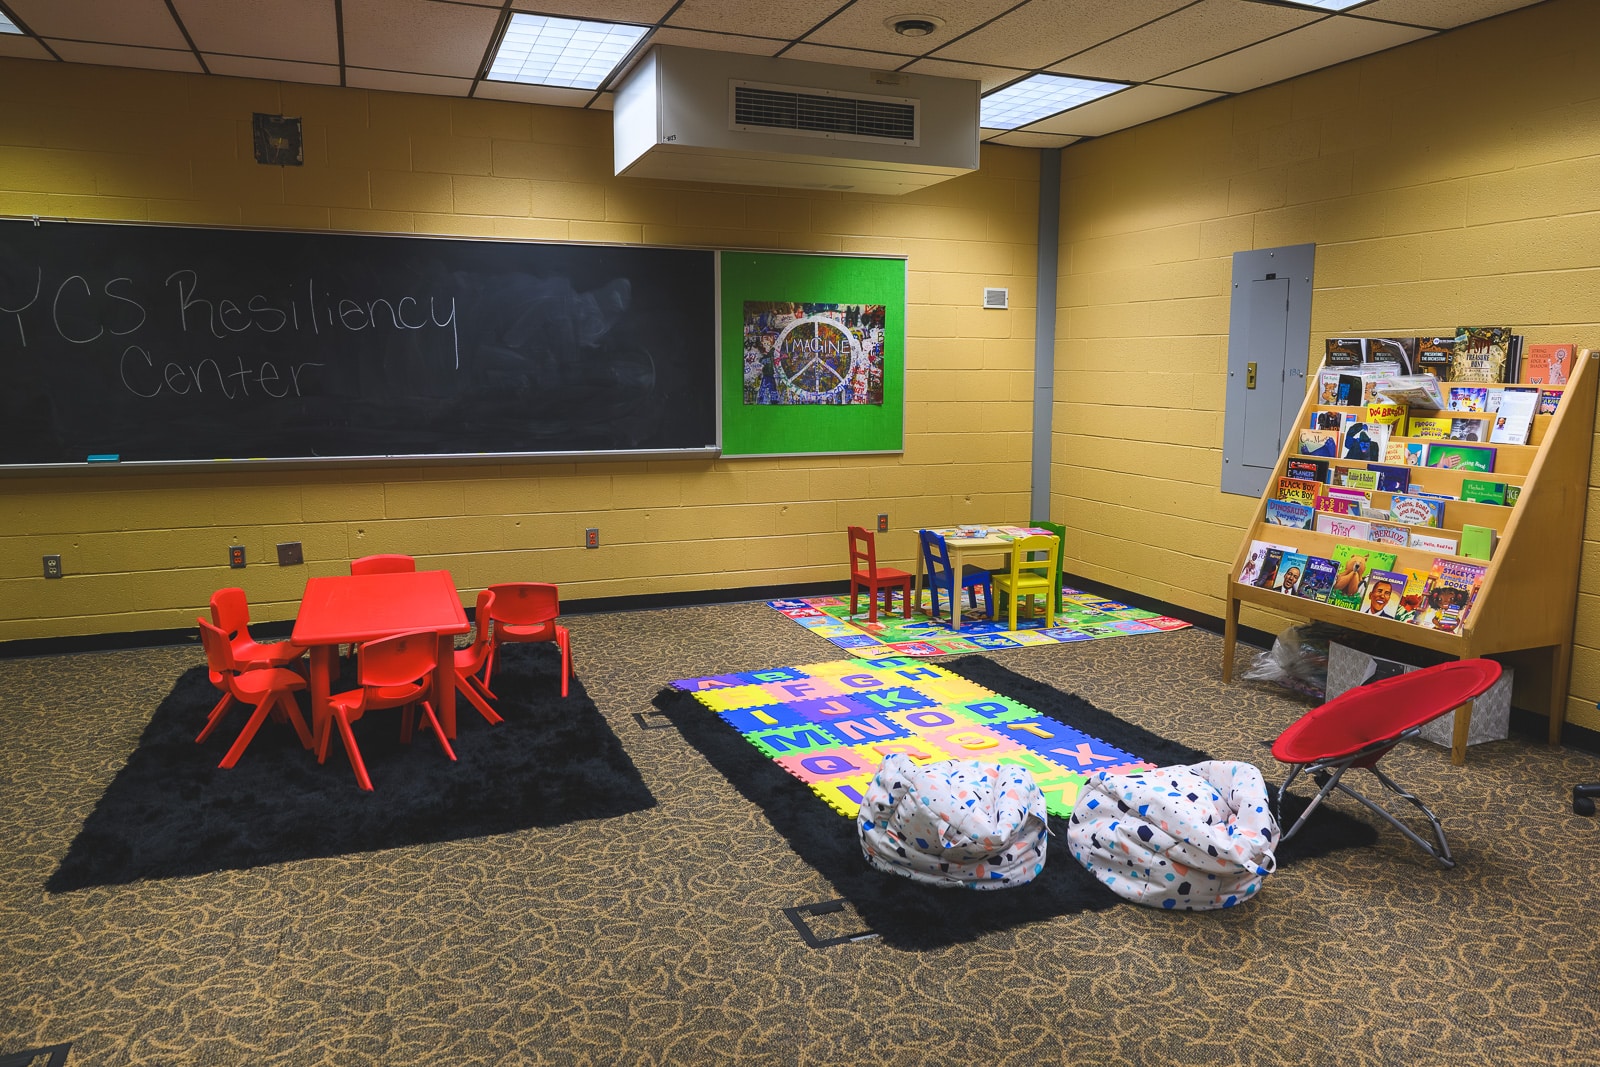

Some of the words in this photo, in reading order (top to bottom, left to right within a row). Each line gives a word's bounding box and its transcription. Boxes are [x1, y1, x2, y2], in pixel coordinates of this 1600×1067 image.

[165, 269, 460, 371] Resiliency
[785, 337, 851, 355] IMAGINE
[119, 345, 326, 400] Center
[1369, 407, 1380, 417] DOG
[1280, 480, 1301, 490] BLACK
[1280, 488, 1300, 498] BLACK
[1270, 502, 1308, 517] DINOSAURS
[1416, 501, 1430, 515] Boats
[1374, 530, 1404, 543] BERLIOZ
[1442, 568, 1476, 580] STACEY'S
[1444, 580, 1468, 590] BOOKS
[1334, 600, 1354, 610] Wants
[697, 679, 735, 691] A
[752, 671, 793, 683] B
[781, 683, 816, 698] F
[839, 673, 884, 688] G
[896, 667, 943, 681] H
[818, 701, 851, 715] J
[866, 691, 922, 707] K
[760, 729, 832, 752] M
[834, 717, 896, 741] N
[965, 701, 1009, 719] P
[1050, 743, 1118, 766] X
[800, 755, 861, 775] Q
